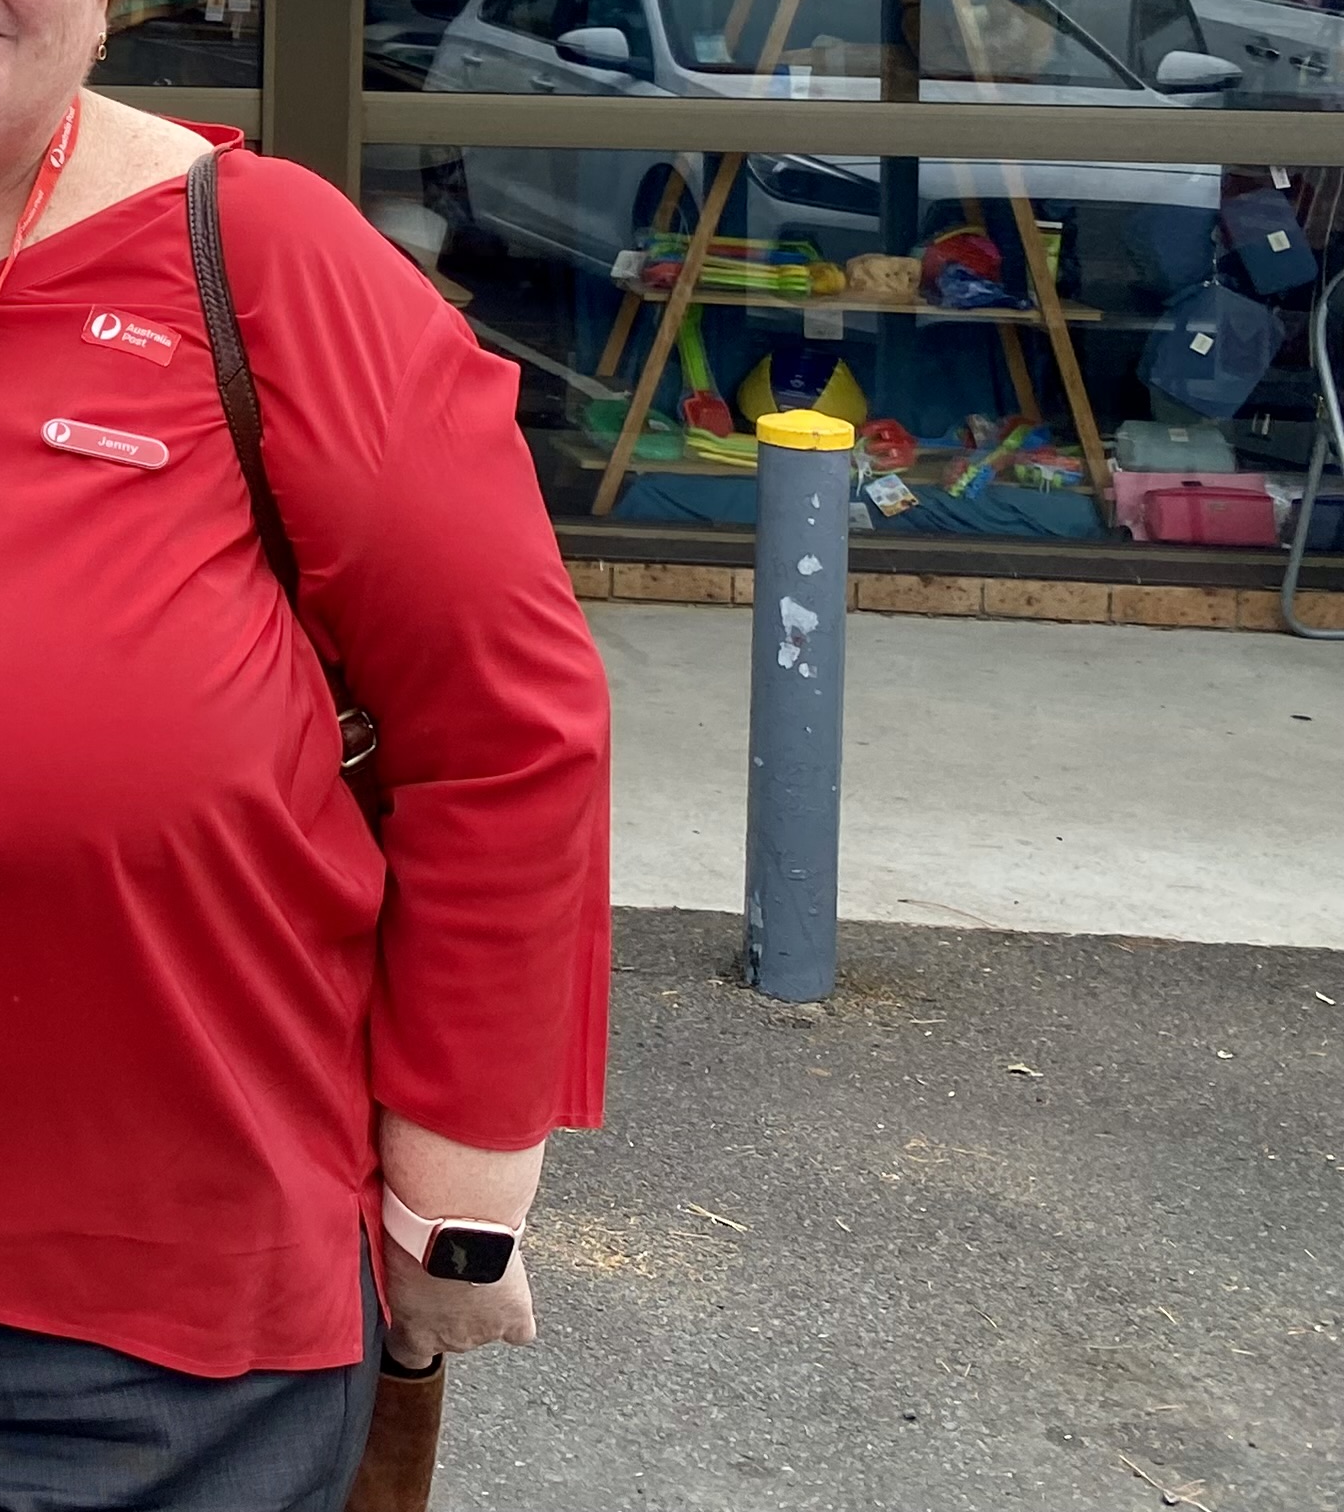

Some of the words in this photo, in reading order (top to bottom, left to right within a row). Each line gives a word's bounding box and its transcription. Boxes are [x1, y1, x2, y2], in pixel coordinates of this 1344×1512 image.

[121, 332, 147, 349] Post
[125, 322, 172, 348] Australia
[97, 435, 139, 455] Jenny
